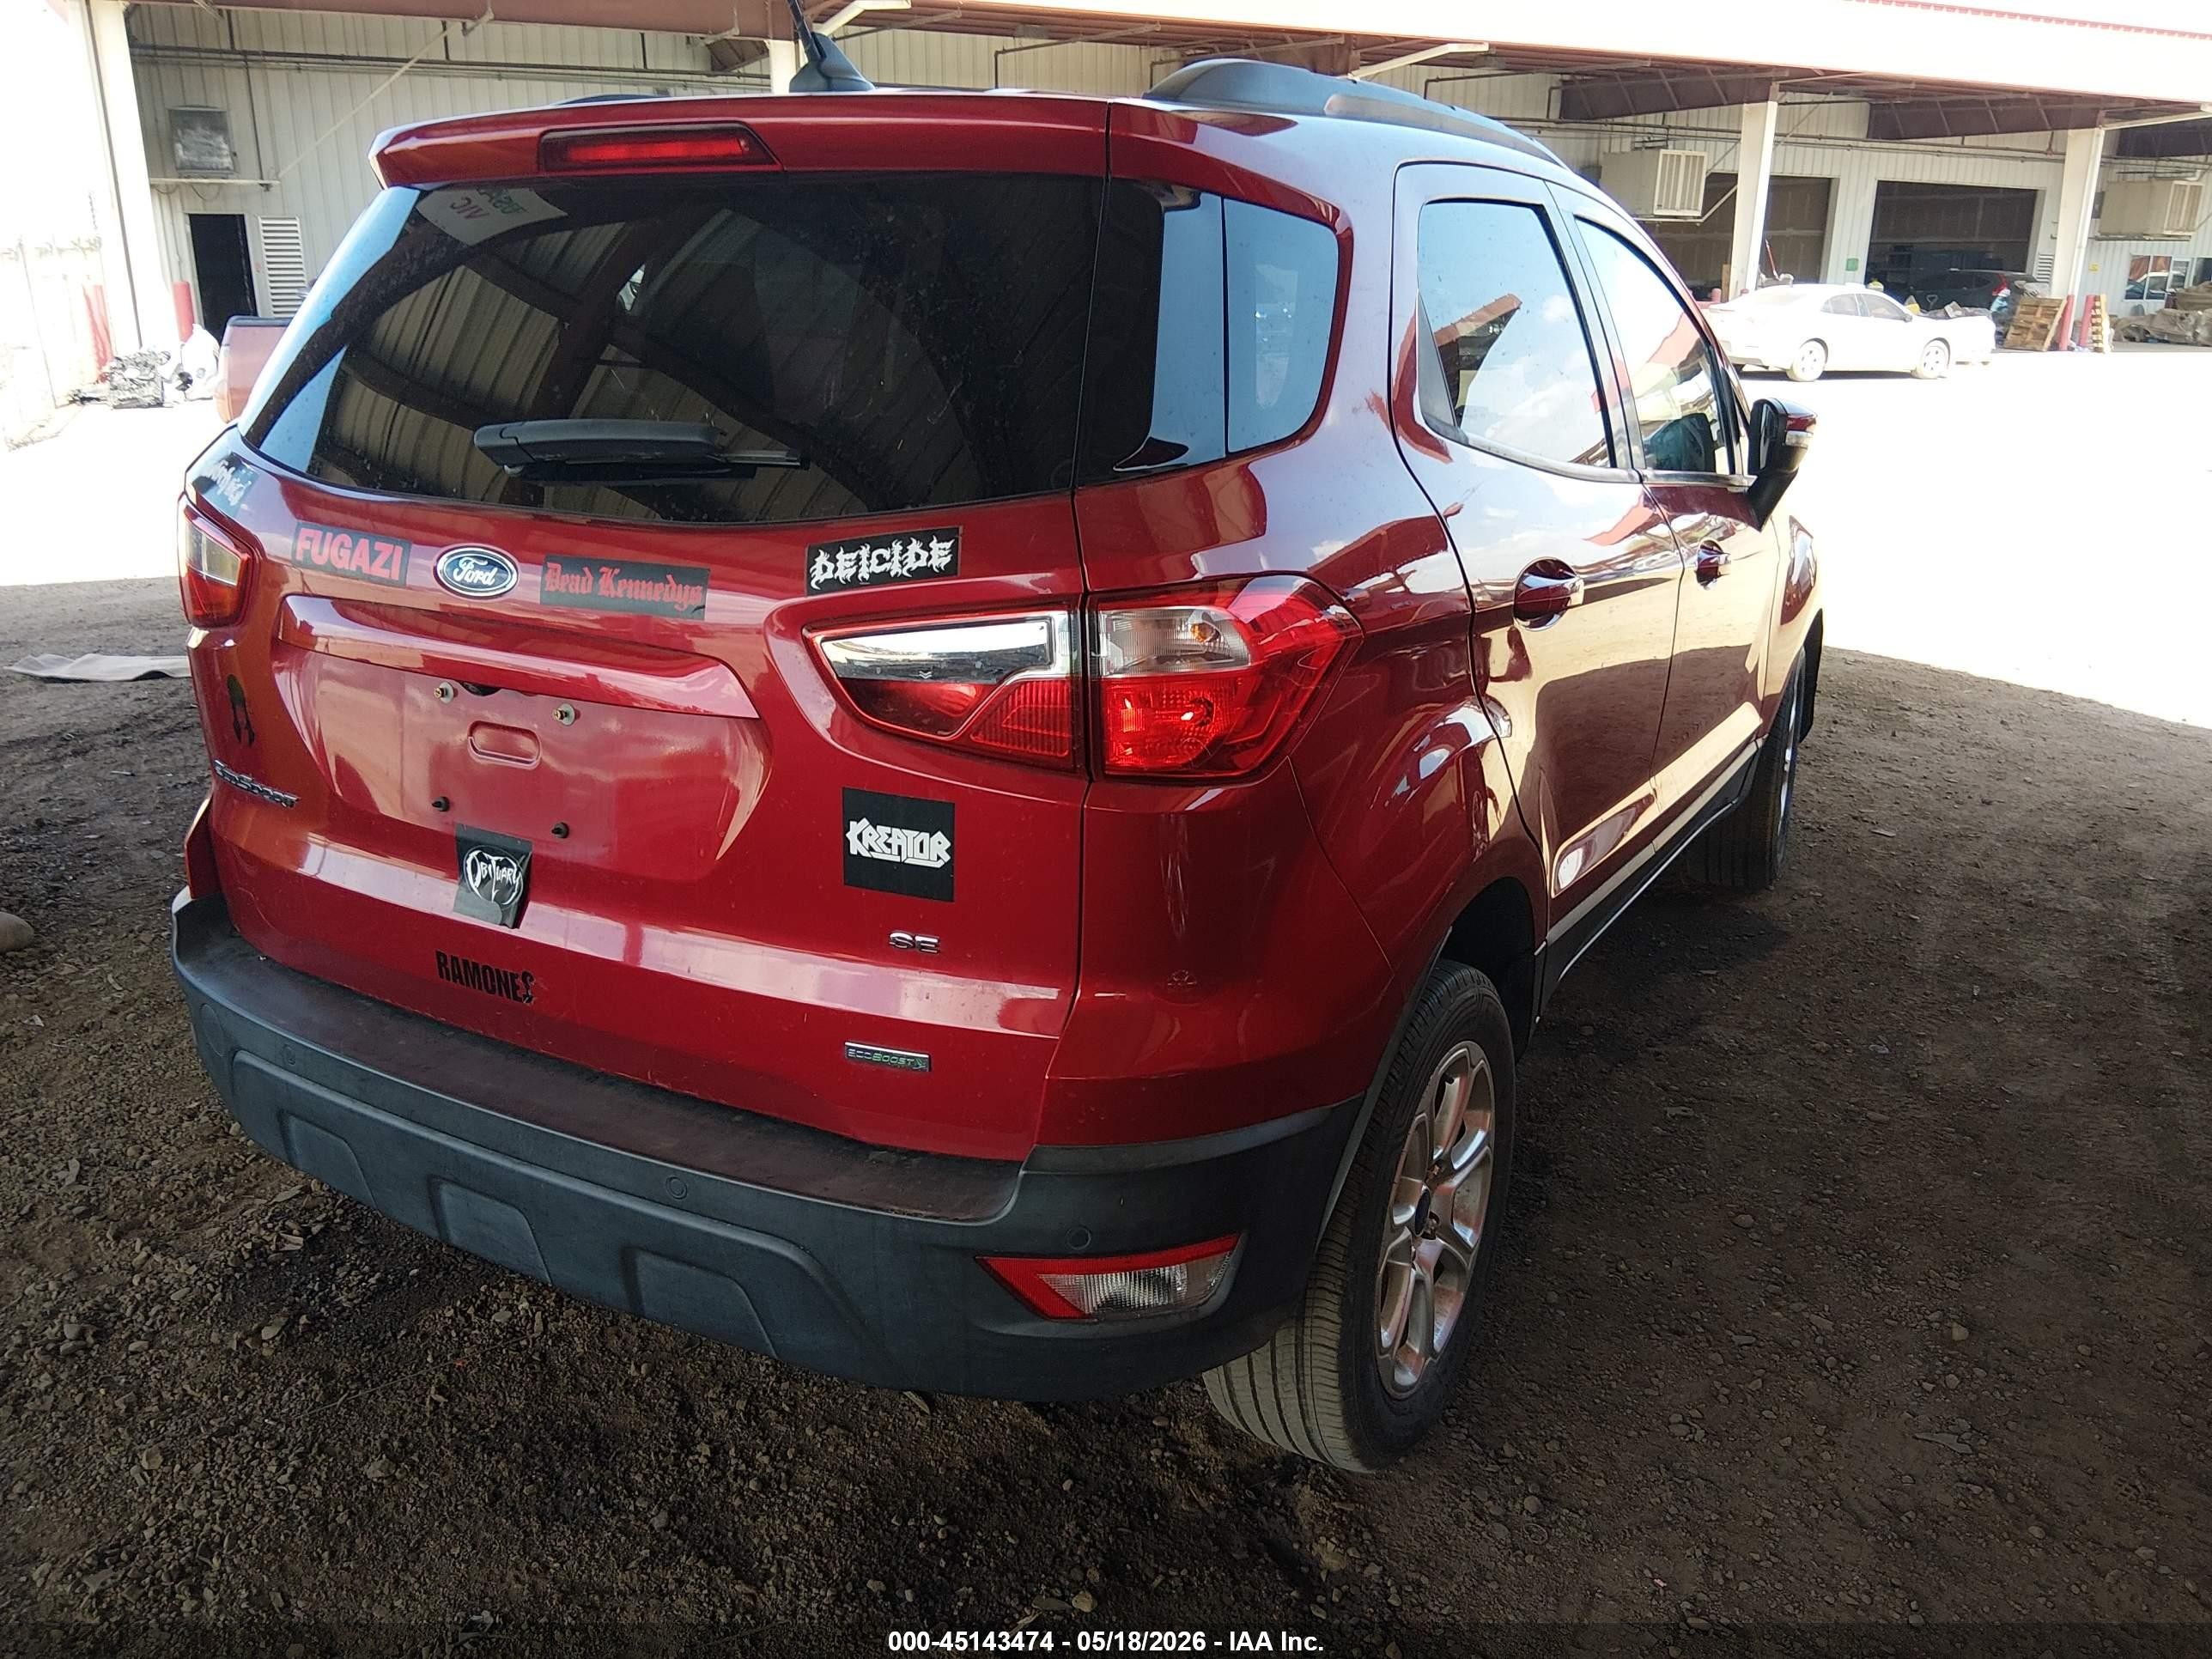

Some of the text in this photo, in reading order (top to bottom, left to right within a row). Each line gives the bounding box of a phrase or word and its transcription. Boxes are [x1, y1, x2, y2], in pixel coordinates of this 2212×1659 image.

[295, 527, 404, 581] FUGAZI
[453, 556, 496, 586] Ford
[810, 535, 956, 590] DEICIDE
[544, 562, 703, 611] Dead Kennedys
[846, 817, 951, 868] KREATOR
[889, 932, 939, 953] SE
[436, 950, 535, 1004] RAMONES
